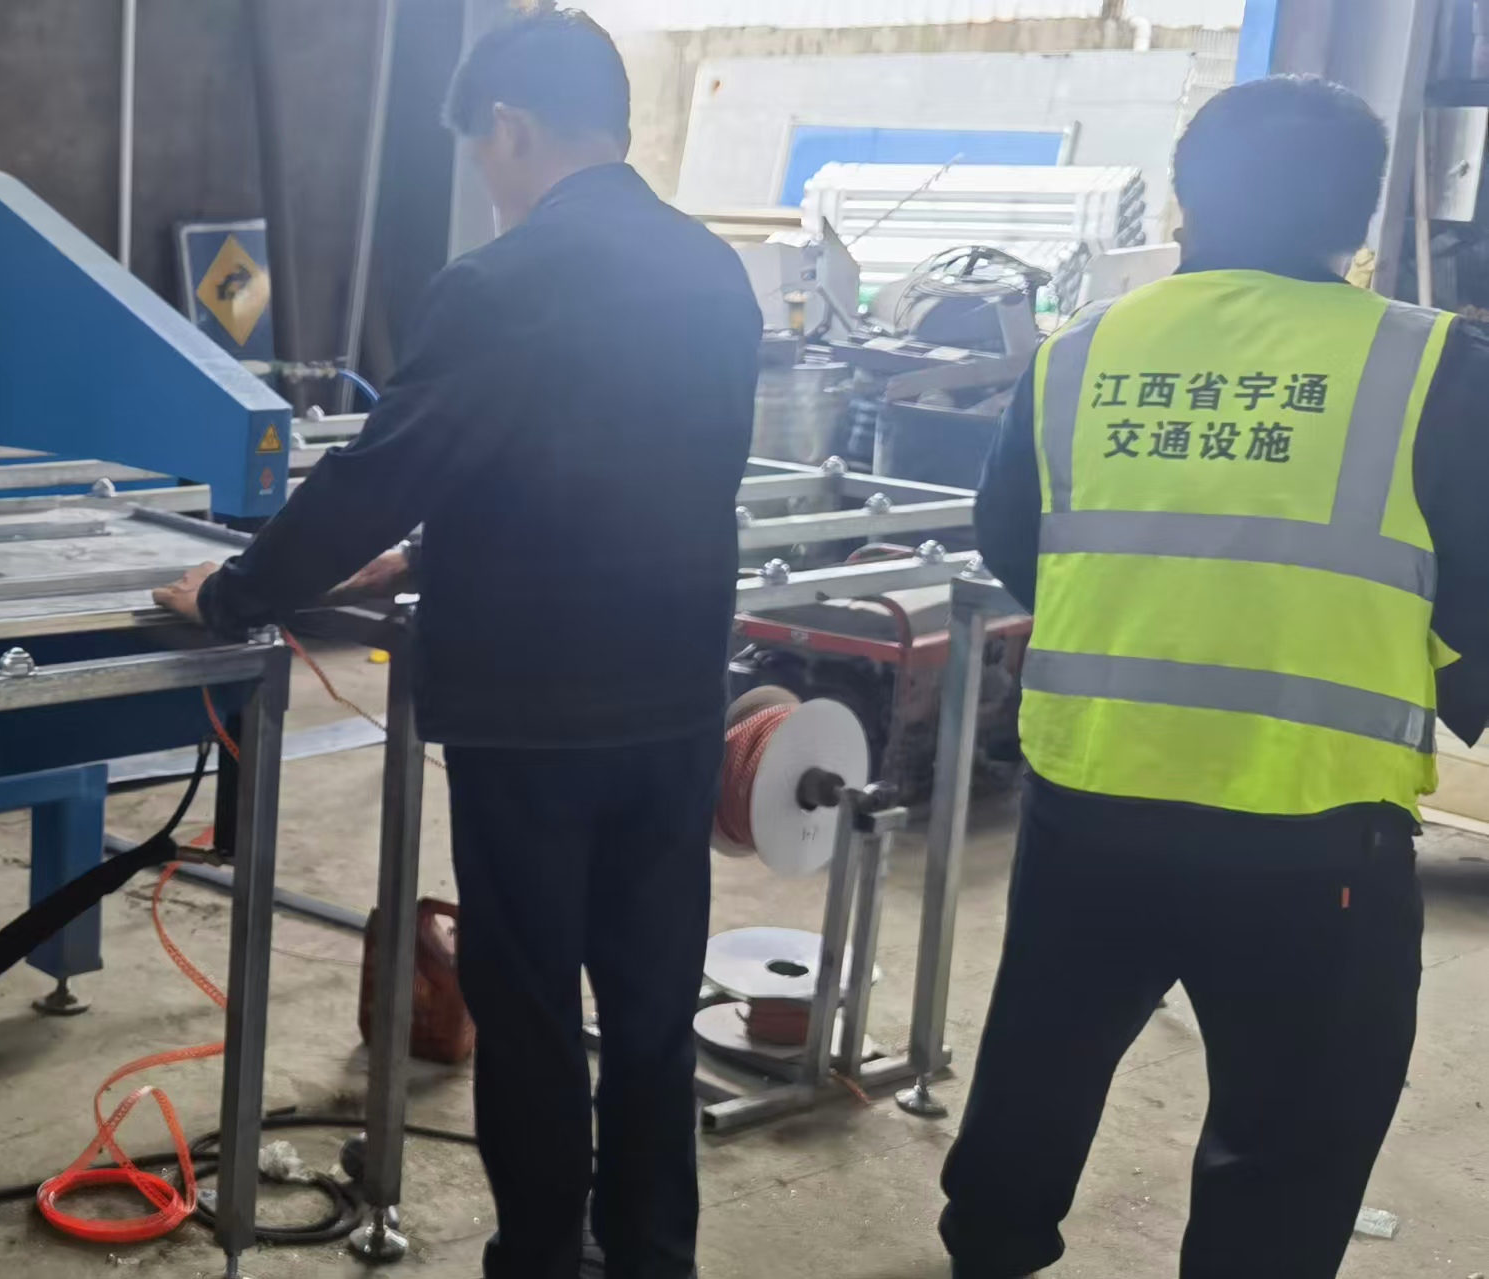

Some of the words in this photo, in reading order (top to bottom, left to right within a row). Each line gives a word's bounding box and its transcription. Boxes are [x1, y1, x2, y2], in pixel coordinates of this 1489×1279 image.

[1091, 371, 1329, 413] 江西省宇通
[1103, 418, 1294, 463] 交通设施
